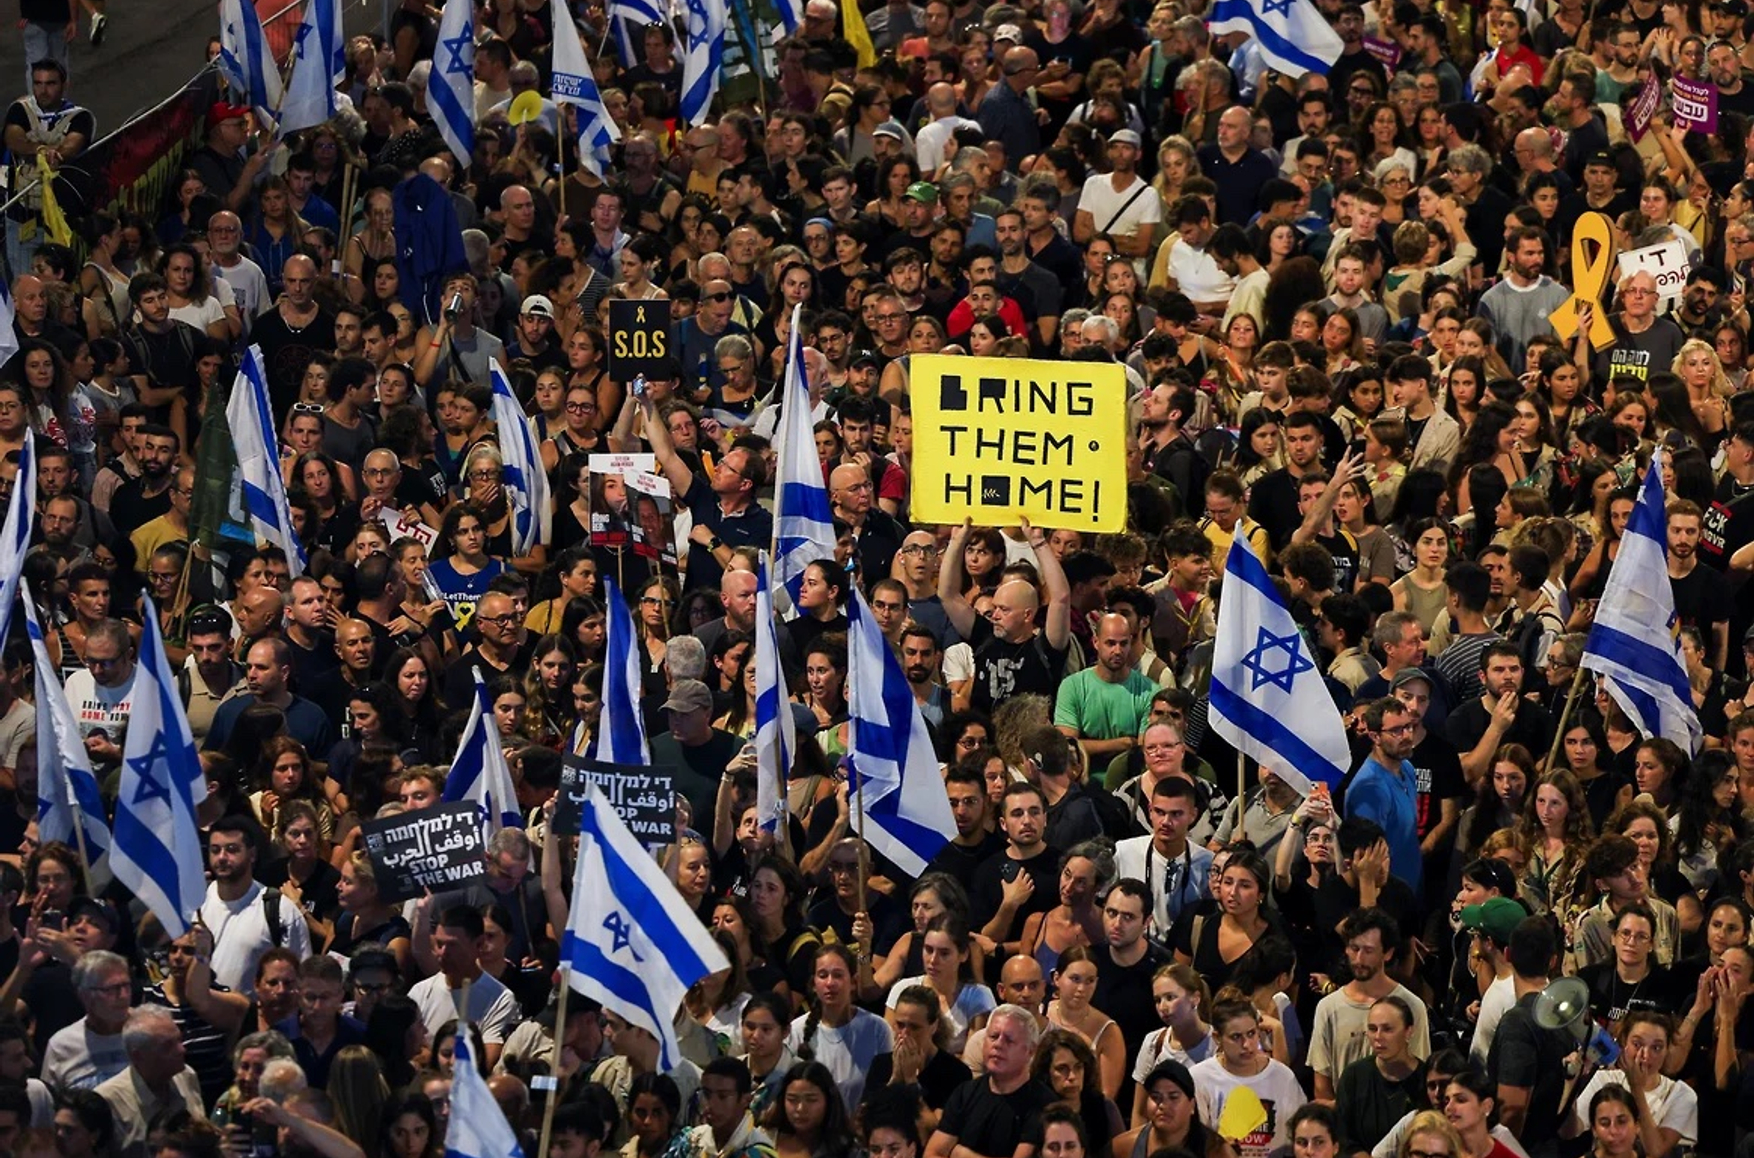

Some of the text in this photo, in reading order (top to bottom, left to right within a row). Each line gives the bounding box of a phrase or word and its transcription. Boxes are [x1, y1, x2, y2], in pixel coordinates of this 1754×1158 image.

[614, 330, 666, 358] S.O.S
[939, 374, 1094, 416] BRING
[939, 425, 1074, 466] THEM
[944, 472, 1100, 523] HOME!
[654, 777, 672, 790] די
[612, 806, 639, 819] OP
[626, 790, 675, 812] أوقف
[384, 813, 453, 844] למלחמה
[456, 811, 474, 826] די
[631, 820, 672, 835] WAR
[434, 825, 481, 852] أوقف
[408, 854, 449, 875] STOP
[413, 870, 445, 886] THE
[444, 860, 485, 882] WAR
